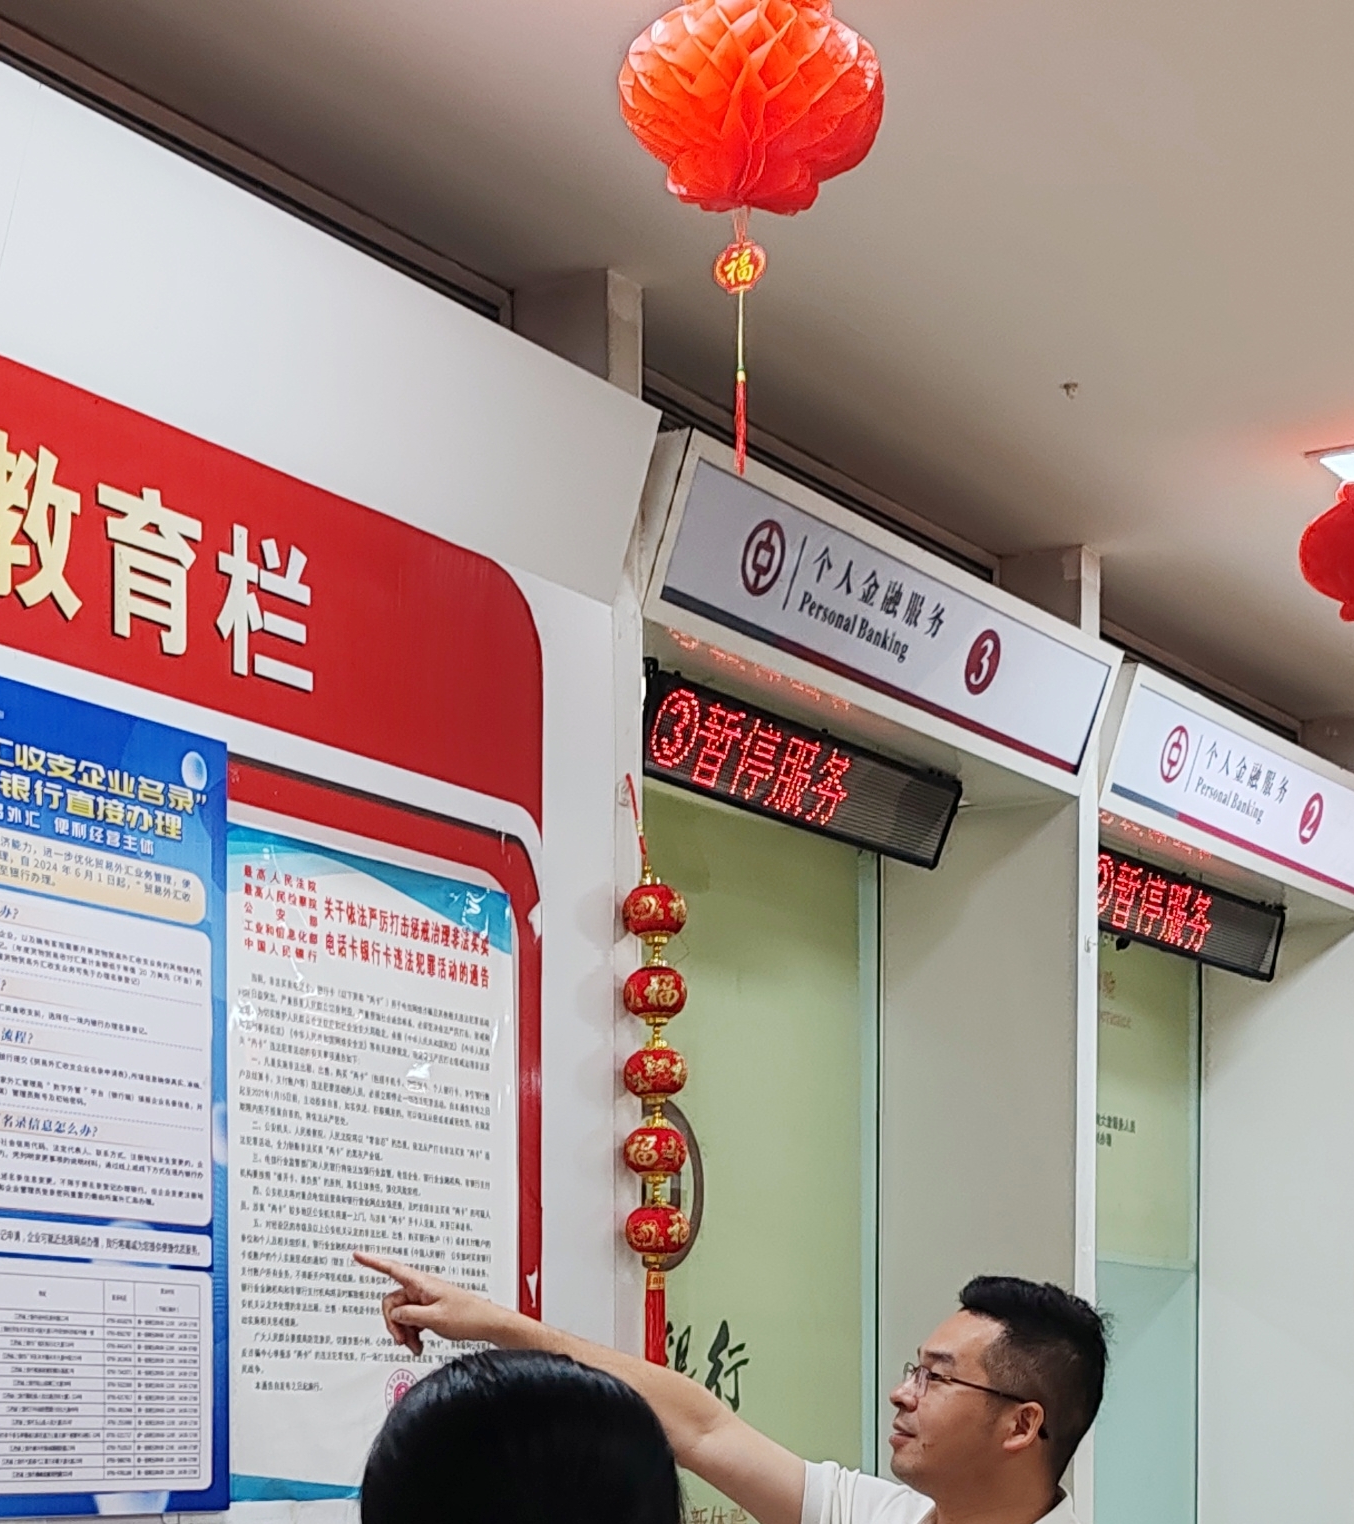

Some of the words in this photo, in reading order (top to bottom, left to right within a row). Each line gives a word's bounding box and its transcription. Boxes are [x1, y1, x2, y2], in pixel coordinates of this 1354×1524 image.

[724, 249, 754, 285] 福
[813, 545, 945, 639] 个人金融服务
[798, 591, 857, 638] Personal
[858, 619, 910, 663] Banking
[967, 634, 999, 691] 3
[1195, 776, 1230, 808] Personal
[1231, 791, 1264, 823] Banking
[1205, 741, 1289, 804] 个人金融服务
[54, 817, 155, 855] 便利经营主体
[1301, 797, 1322, 840] 2
[325, 932, 489, 989] 电话卡银行卡违法犯罪活动的通告
